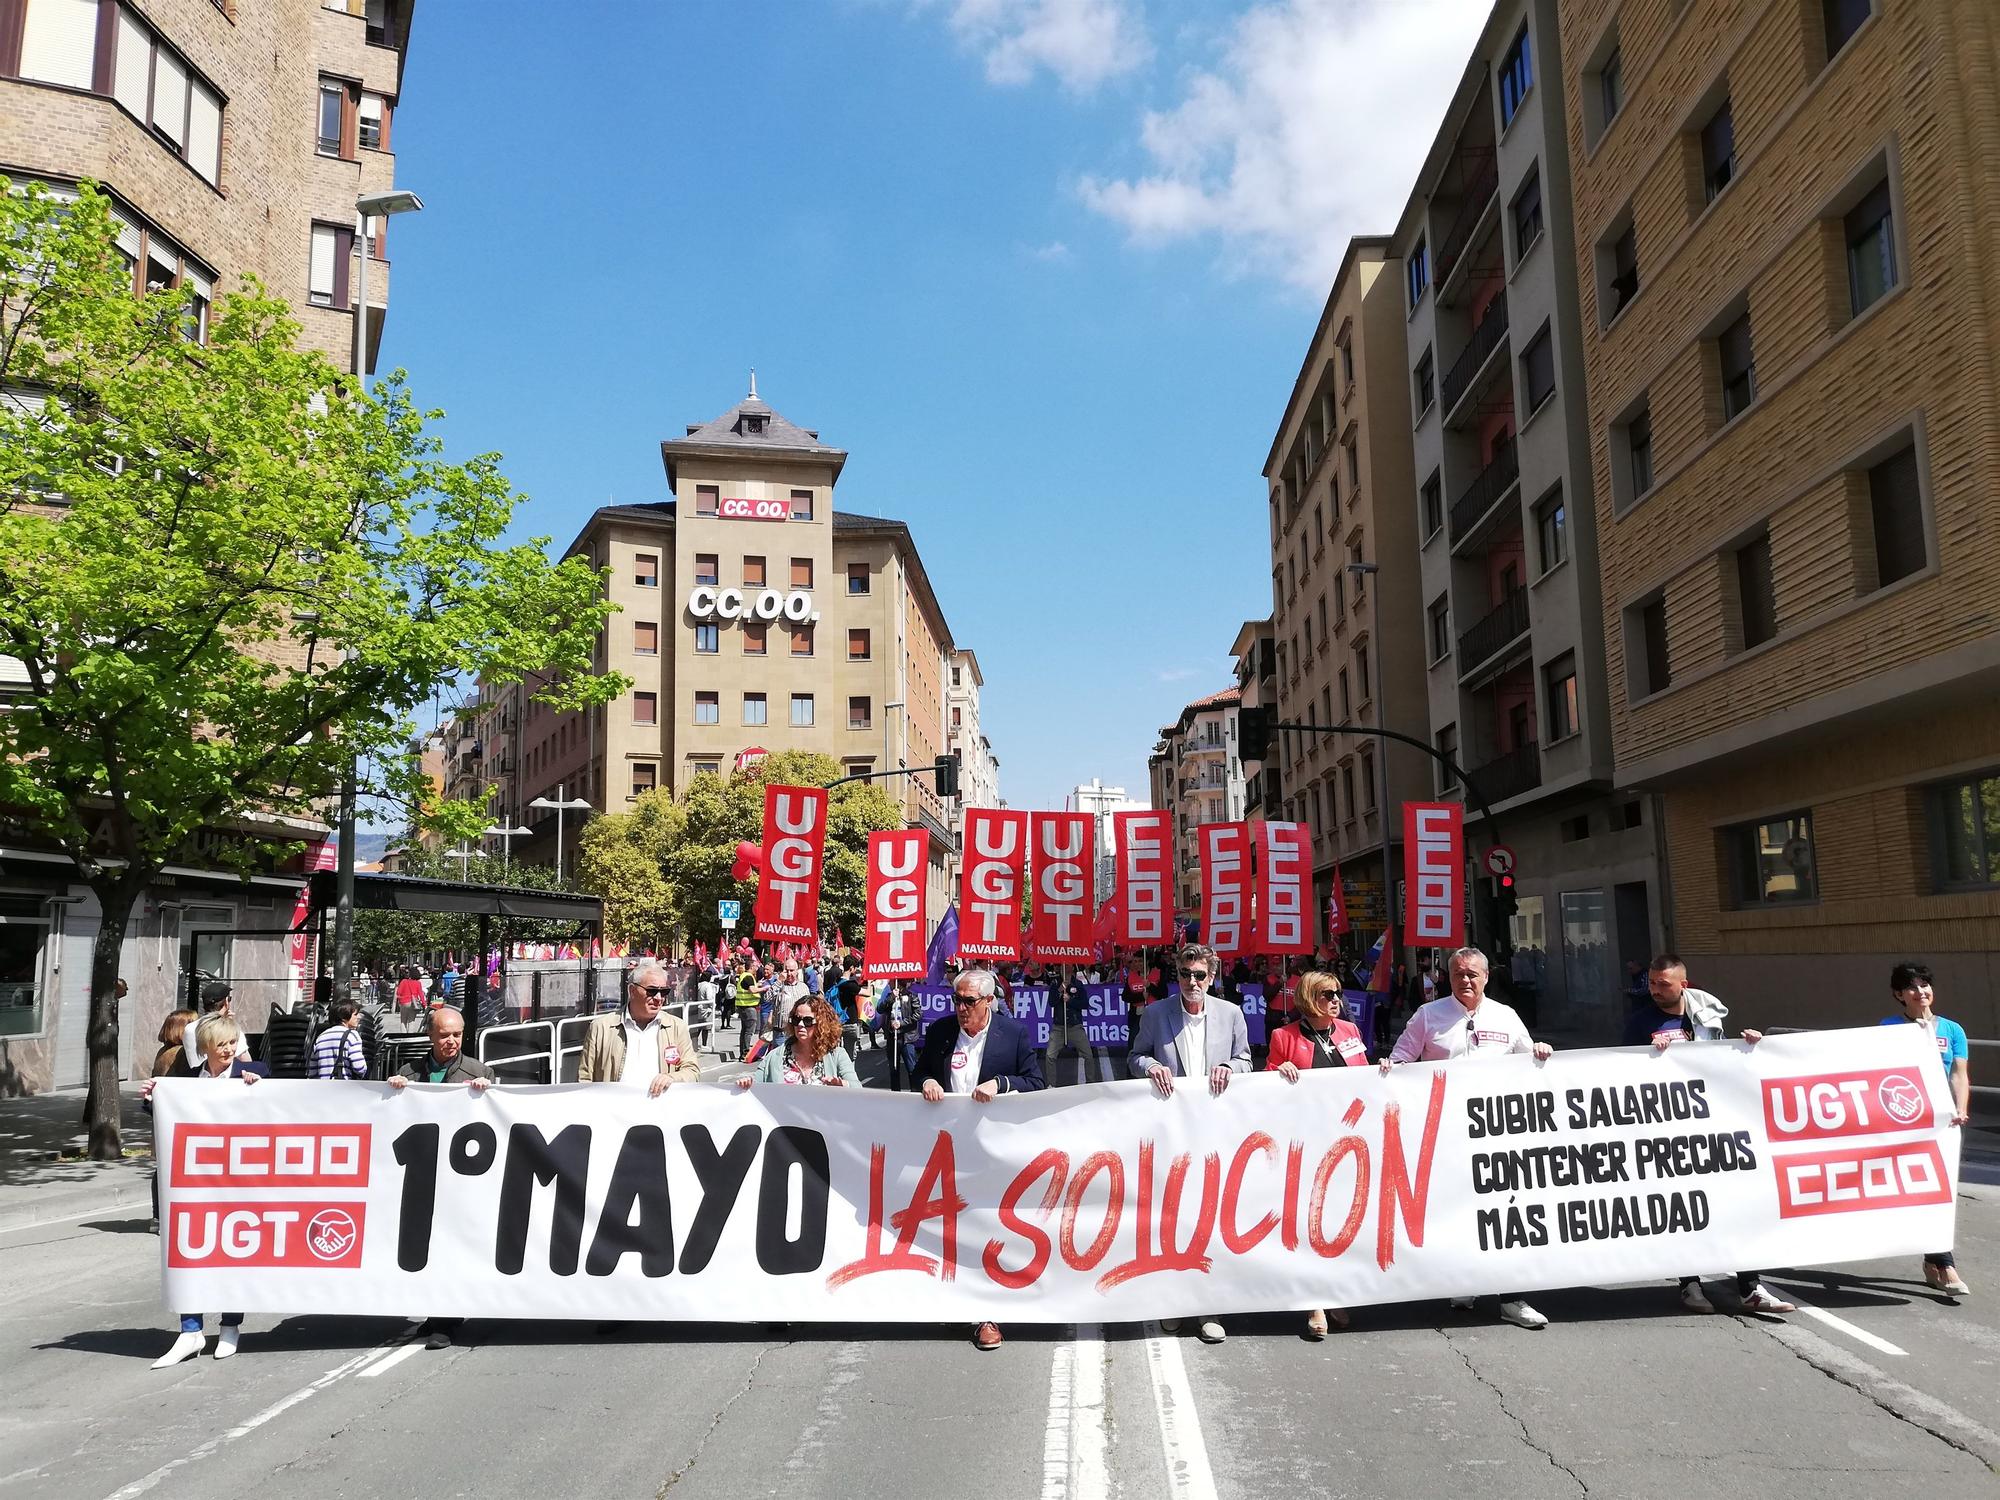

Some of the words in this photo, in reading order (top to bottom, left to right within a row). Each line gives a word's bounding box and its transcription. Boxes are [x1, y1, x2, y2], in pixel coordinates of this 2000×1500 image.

[689, 587, 820, 620] CC.OO.
[771, 793, 817, 921] UGT
[972, 817, 1018, 942] UGT
[1040, 820, 1086, 942] UGT
[1416, 809, 1451, 937] CCOO
[876, 838, 919, 960] UGT
[758, 922, 813, 938] NAVARRA
[961, 943, 1016, 957] NAVARRA
[1036, 946, 1091, 957] NAVARRA
[867, 961, 923, 975] NAVARRA
[1467, 1091, 1558, 1138] SUBIR
[1567, 1079, 1711, 1129] SALARIOS
[1770, 1079, 1870, 1134] UGT
[183, 1135, 361, 1176] CCOO
[826, 1130, 968, 1294] LA
[983, 1069, 1447, 1294] SOLUCIÓN
[1472, 1143, 1630, 1194] CONTENER
[1636, 1131, 1757, 1180] PRECIOS
[1786, 1151, 1942, 1207] CCOO
[177, 1209, 300, 1261] UGT
[1477, 1195, 1548, 1251] MÁS
[1558, 1190, 1710, 1244] IGUALDAD
